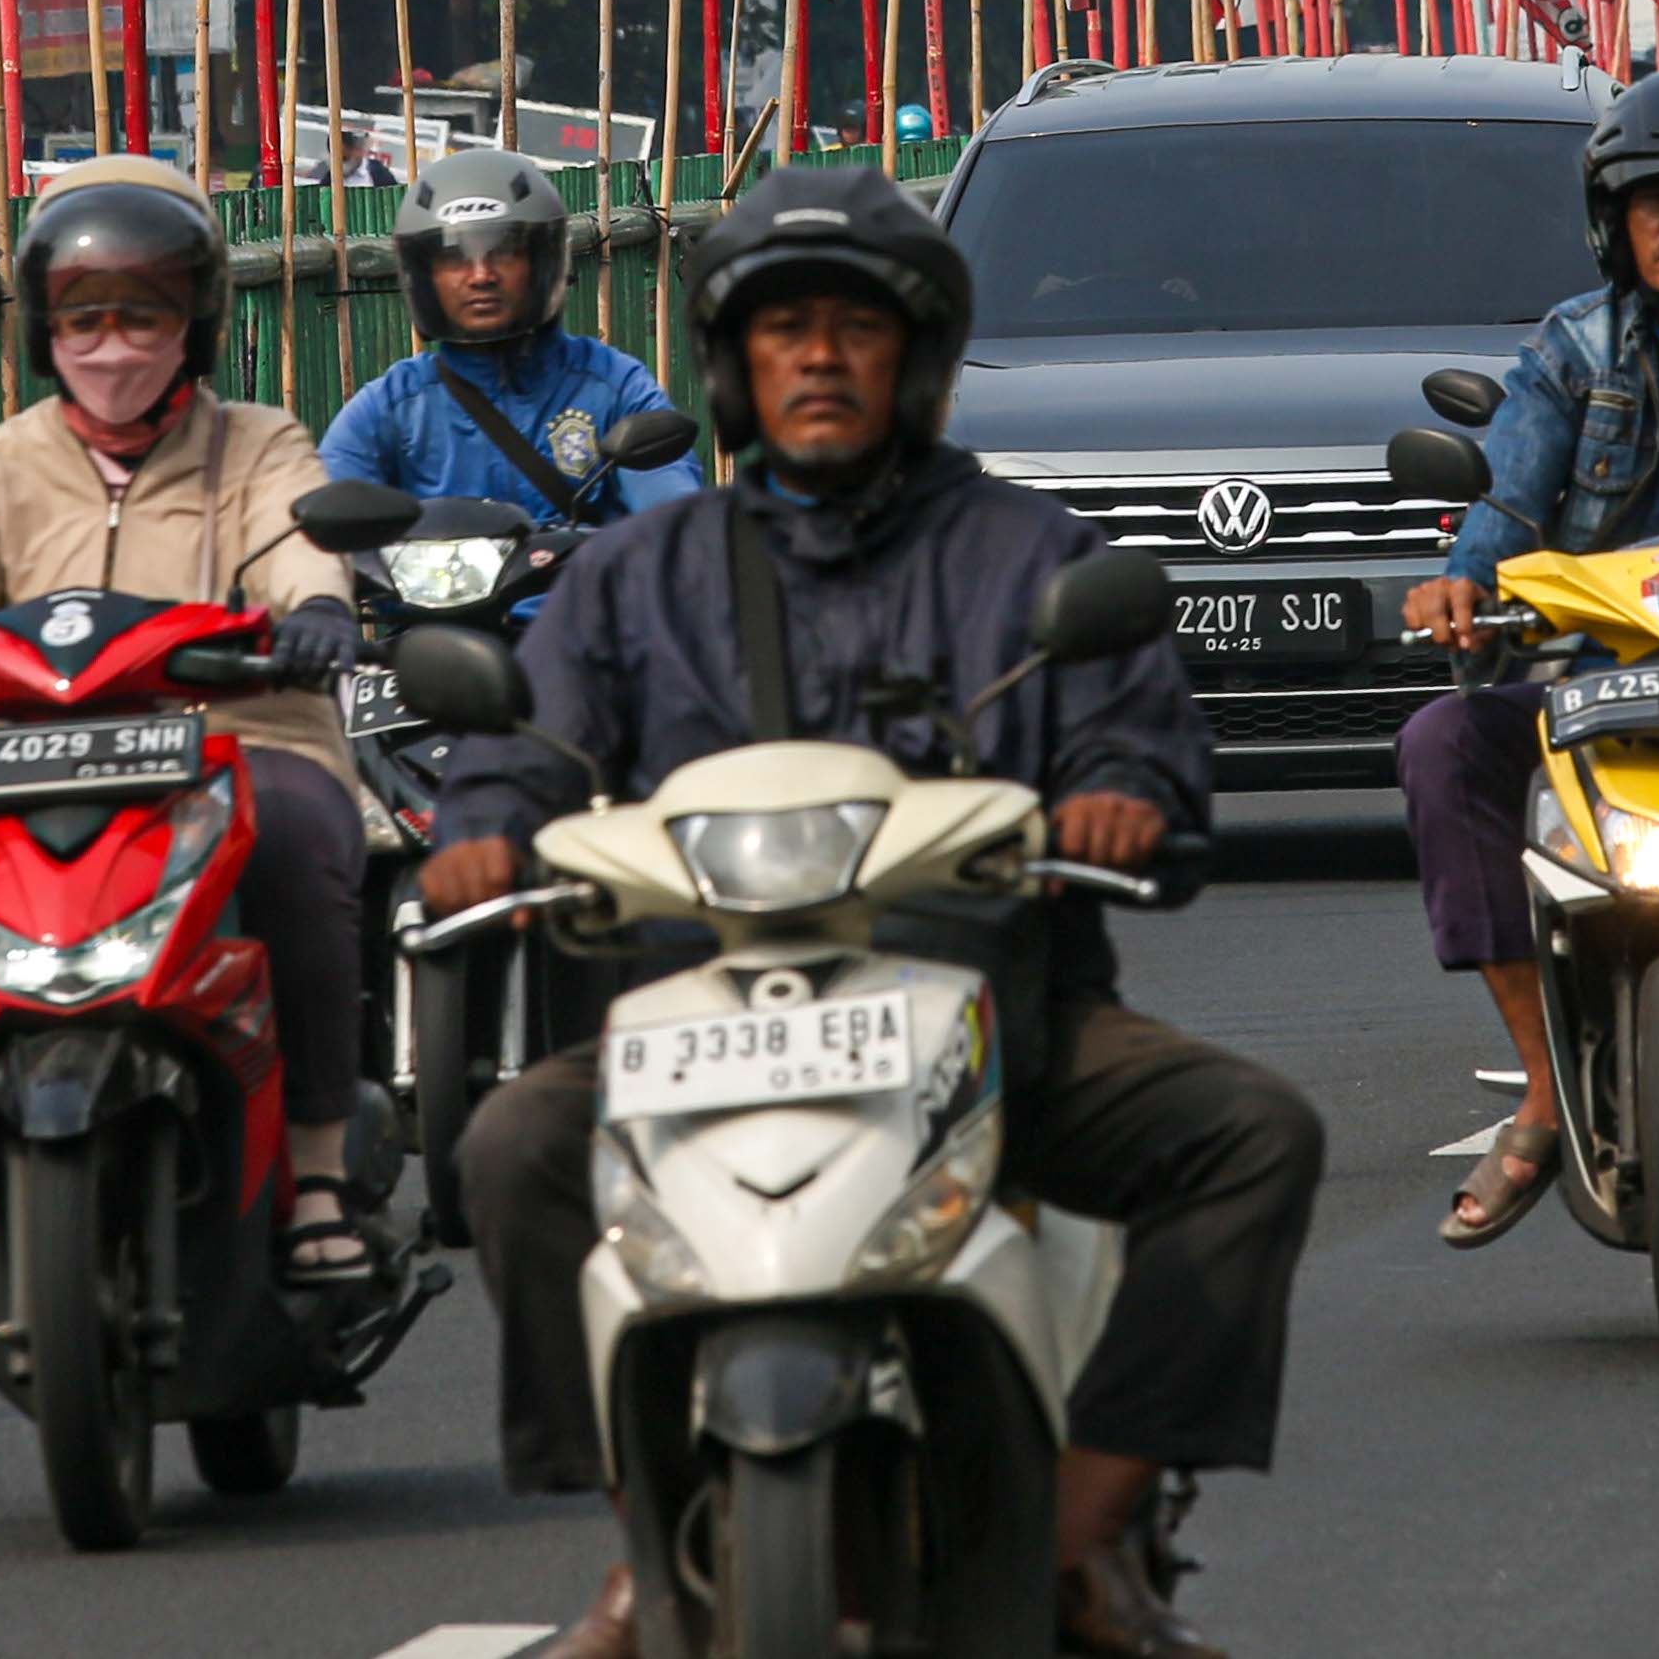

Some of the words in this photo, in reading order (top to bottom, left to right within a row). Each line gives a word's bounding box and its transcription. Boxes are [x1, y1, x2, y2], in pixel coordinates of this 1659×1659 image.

[443, 203, 500, 216] INK
[1175, 595, 1257, 634] 2207
[1281, 593, 1343, 631] SJC
[356, 677, 375, 704] B
[1563, 689, 1582, 713] B
[622, 1040, 645, 1071] B
